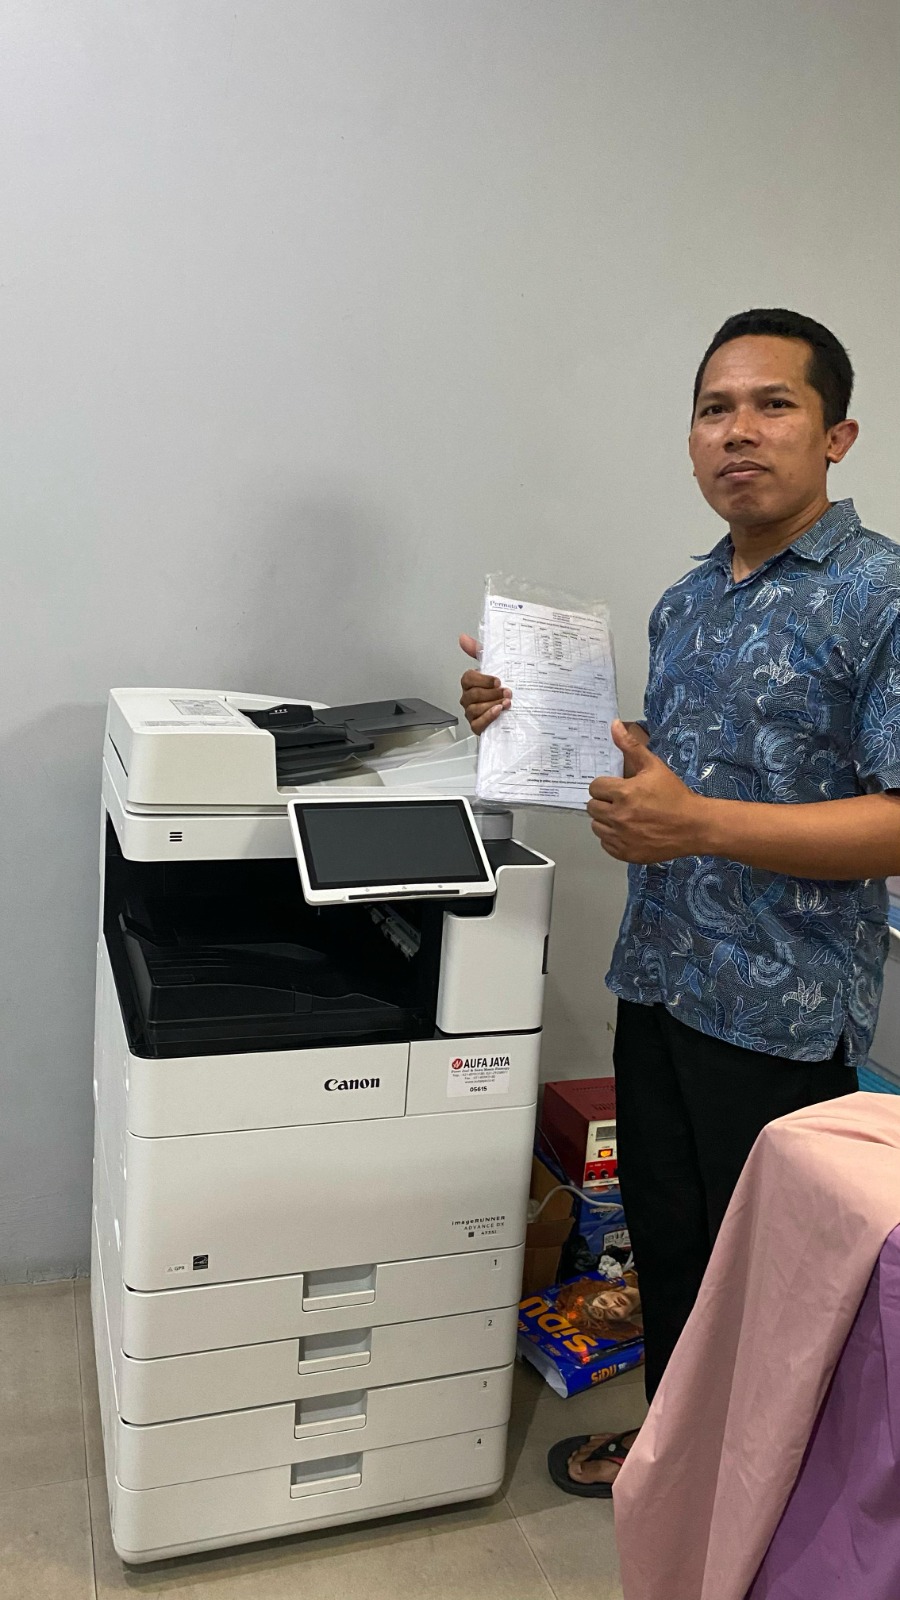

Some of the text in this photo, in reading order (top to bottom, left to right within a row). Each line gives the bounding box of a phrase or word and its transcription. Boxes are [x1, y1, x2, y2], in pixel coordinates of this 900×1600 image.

[463, 1056, 510, 1068] AUFA JAYA
[324, 1077, 380, 1092] Canon
[451, 1216, 505, 1226] imageRUNNER
[487, 1319, 493, 1327] 2
[518, 1296, 598, 1353] SiDU
[591, 1364, 617, 1384] SiDU
[476, 1437, 482, 1445] 4
